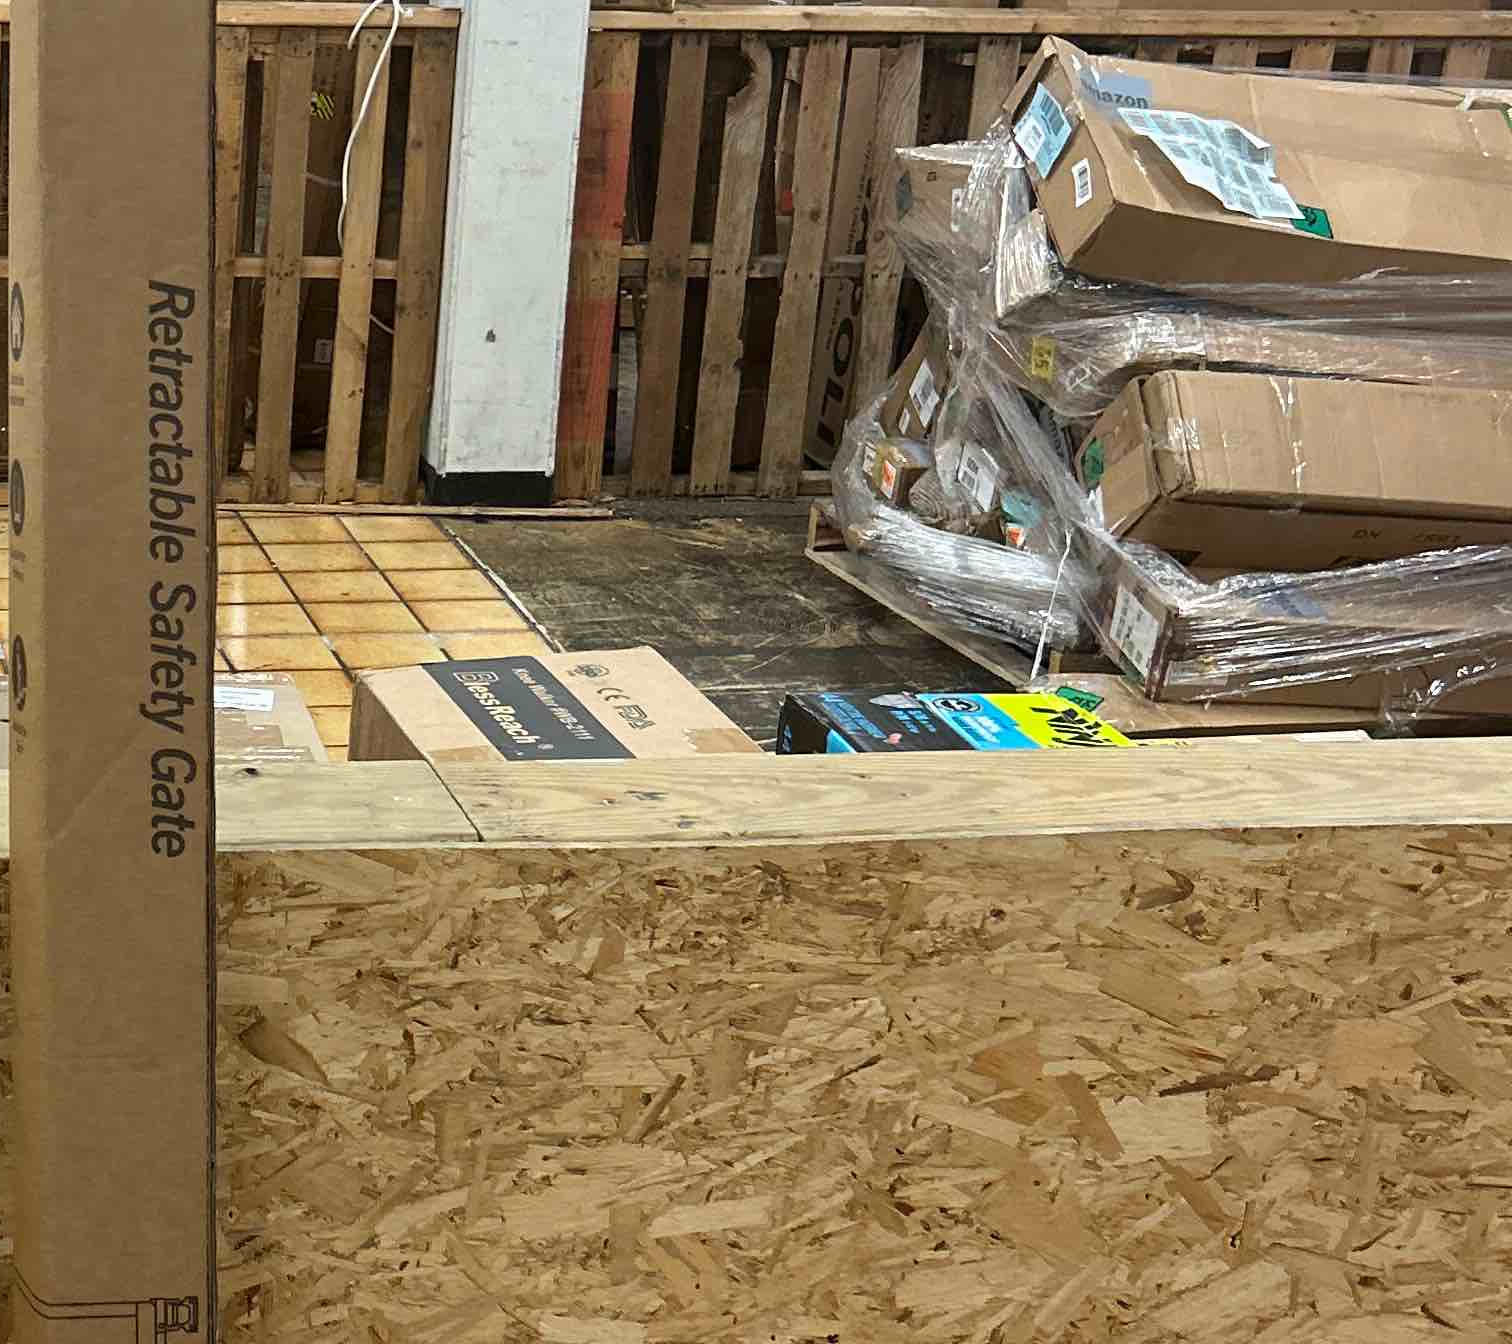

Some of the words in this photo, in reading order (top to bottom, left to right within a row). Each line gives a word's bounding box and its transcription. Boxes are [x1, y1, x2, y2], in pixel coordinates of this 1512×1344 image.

[147, 279, 196, 565] Retractable
[140, 581, 196, 733] Safety
[152, 749, 196, 858] Gate
